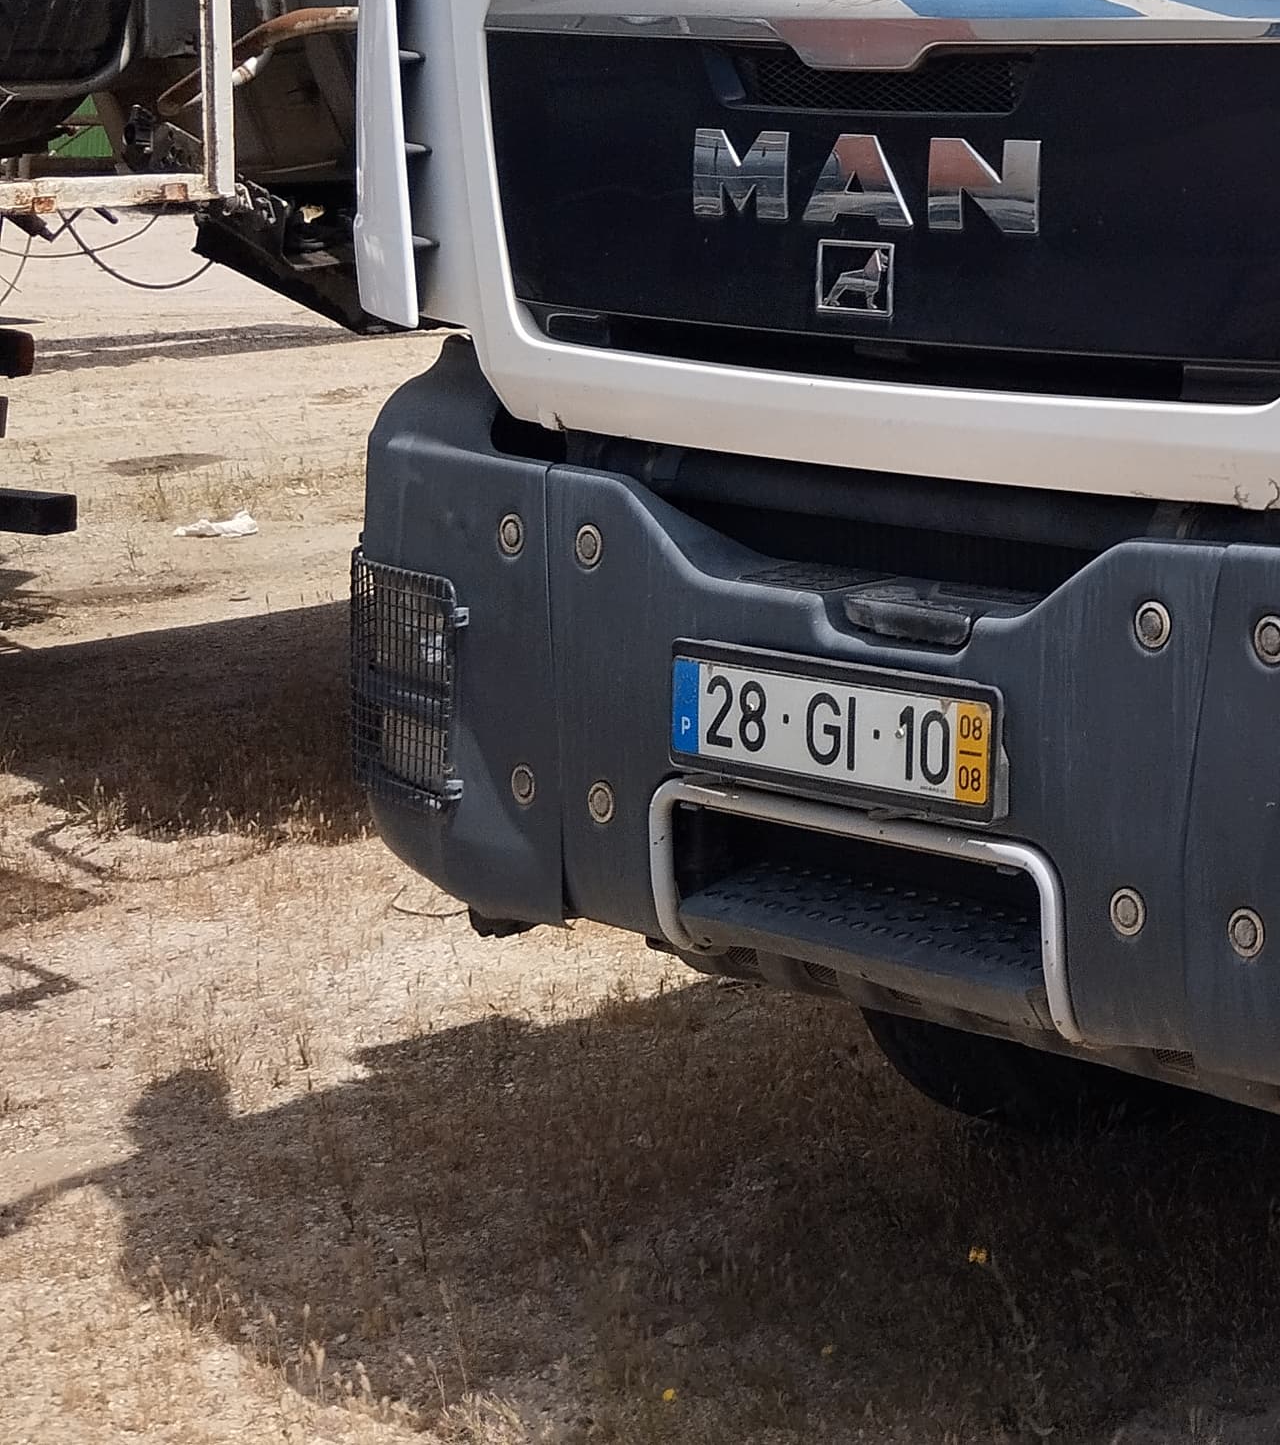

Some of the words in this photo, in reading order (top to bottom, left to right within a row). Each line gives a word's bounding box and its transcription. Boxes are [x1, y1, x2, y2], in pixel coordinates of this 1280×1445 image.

[693, 128, 1042, 234] MAN
[681, 716, 691, 735] P
[959, 714, 983, 741] 08
[958, 765, 981, 792] 08
